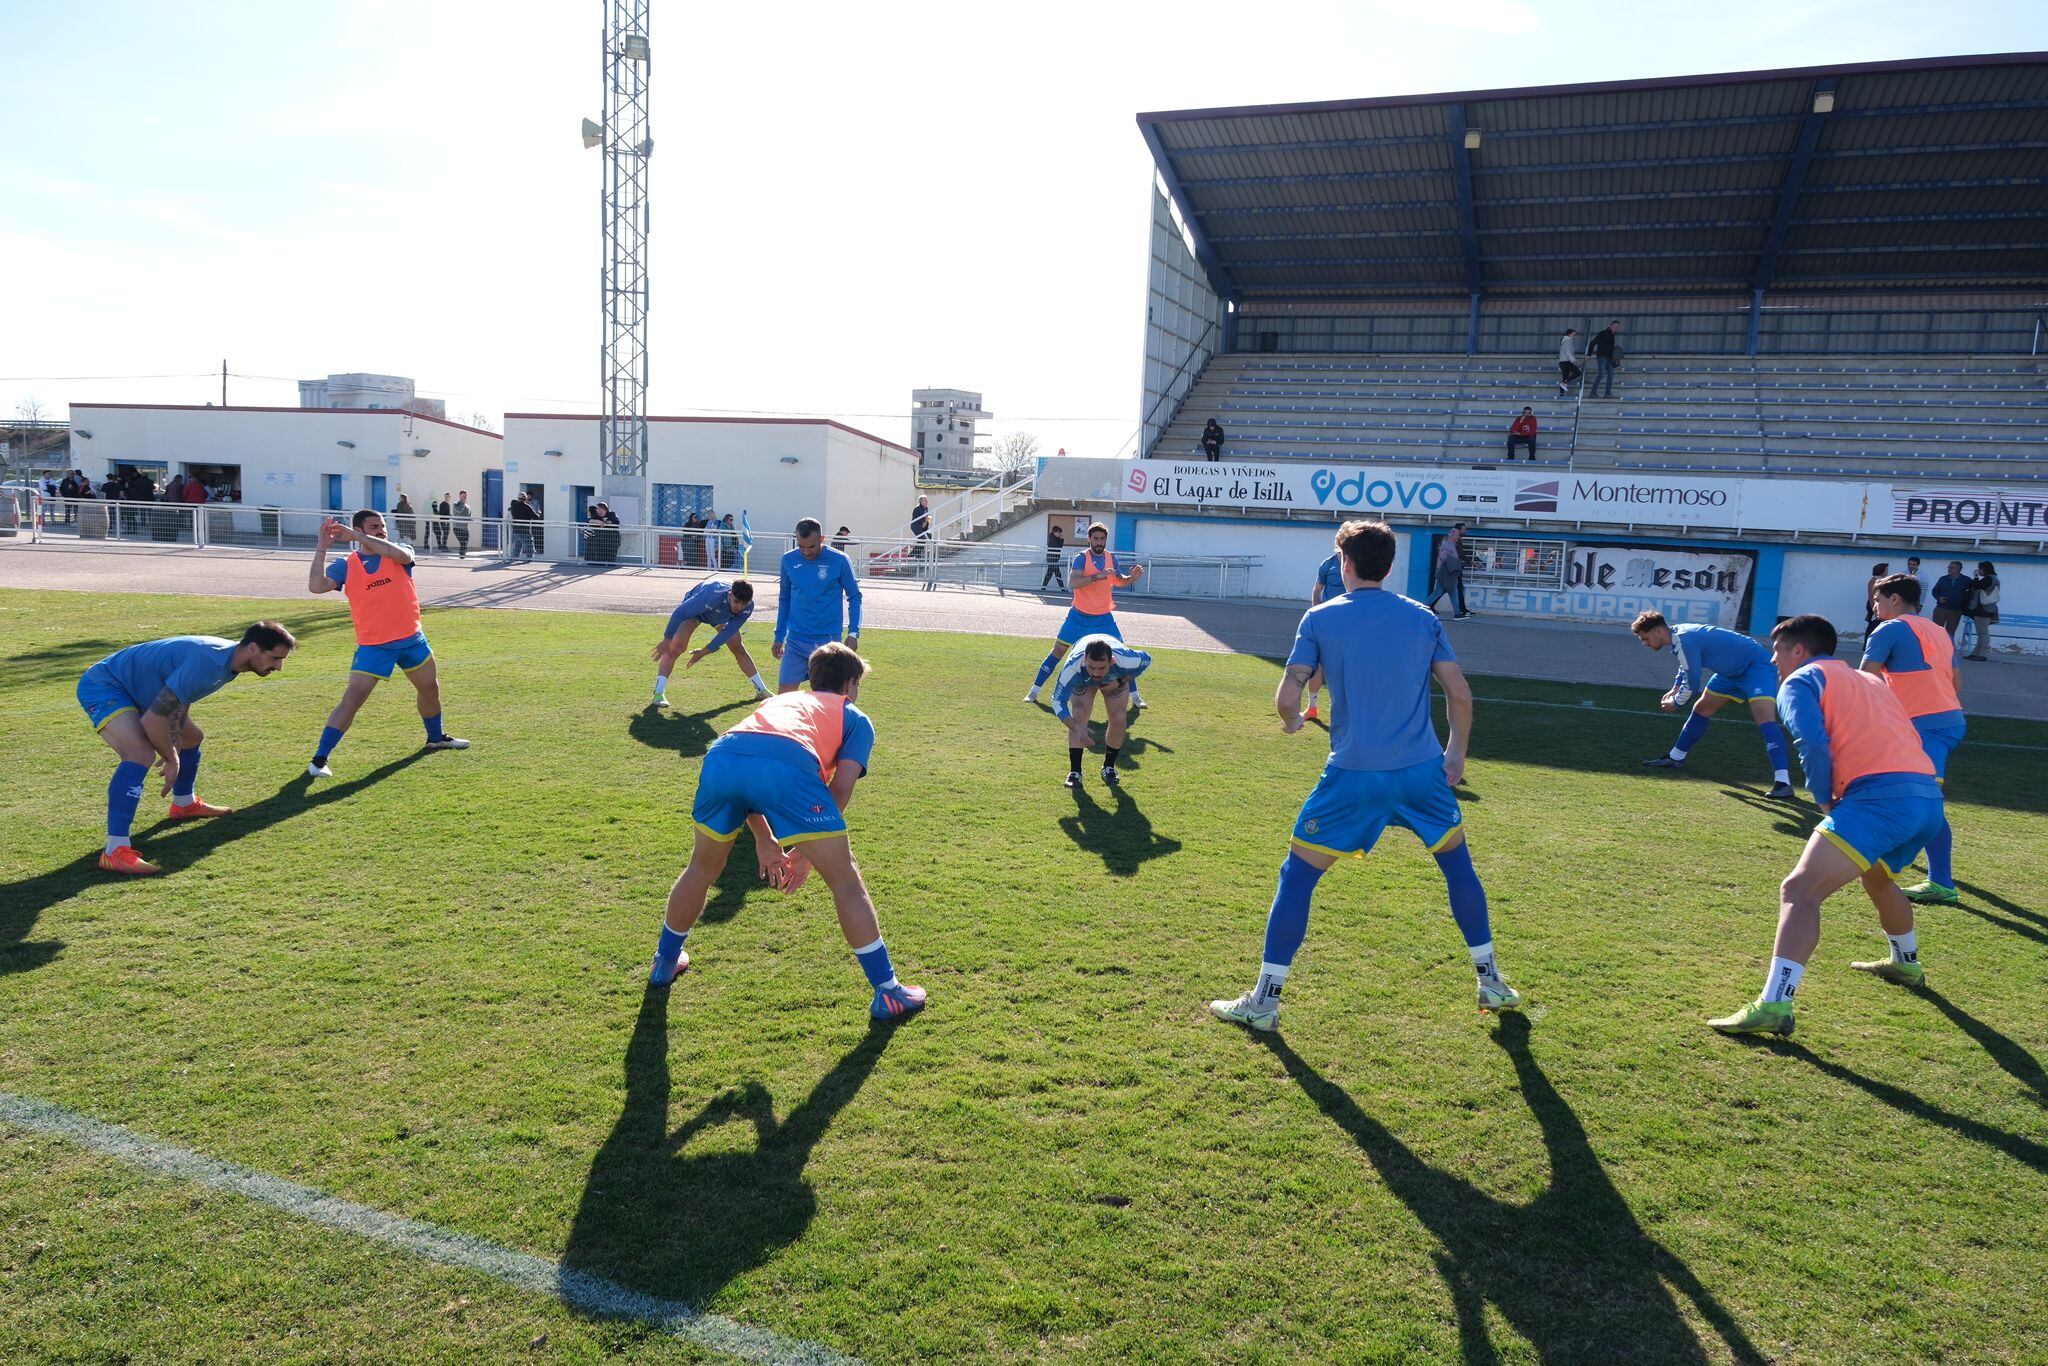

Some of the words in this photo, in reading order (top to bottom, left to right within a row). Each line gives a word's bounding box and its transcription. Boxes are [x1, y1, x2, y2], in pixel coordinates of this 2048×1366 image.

[1174, 466, 1220, 476] BODEGAS
[1222, 467, 1228, 476] Y
[1231, 466, 1276, 478] VIÑEDOS
[1395, 471, 1425, 480] Marketing
[1426, 473, 1445, 481] digital
[1154, 477, 1170, 496] El
[1176, 478, 1223, 503] Lagar
[1229, 480, 1248, 499] de
[1253, 481, 1293, 502] Isilla
[1336, 471, 1447, 510] dovo
[1572, 479, 1727, 507] Montermoso
[1621, 558, 1738, 594] Mesón
[1466, 590, 1711, 623] RESTAURANTE
